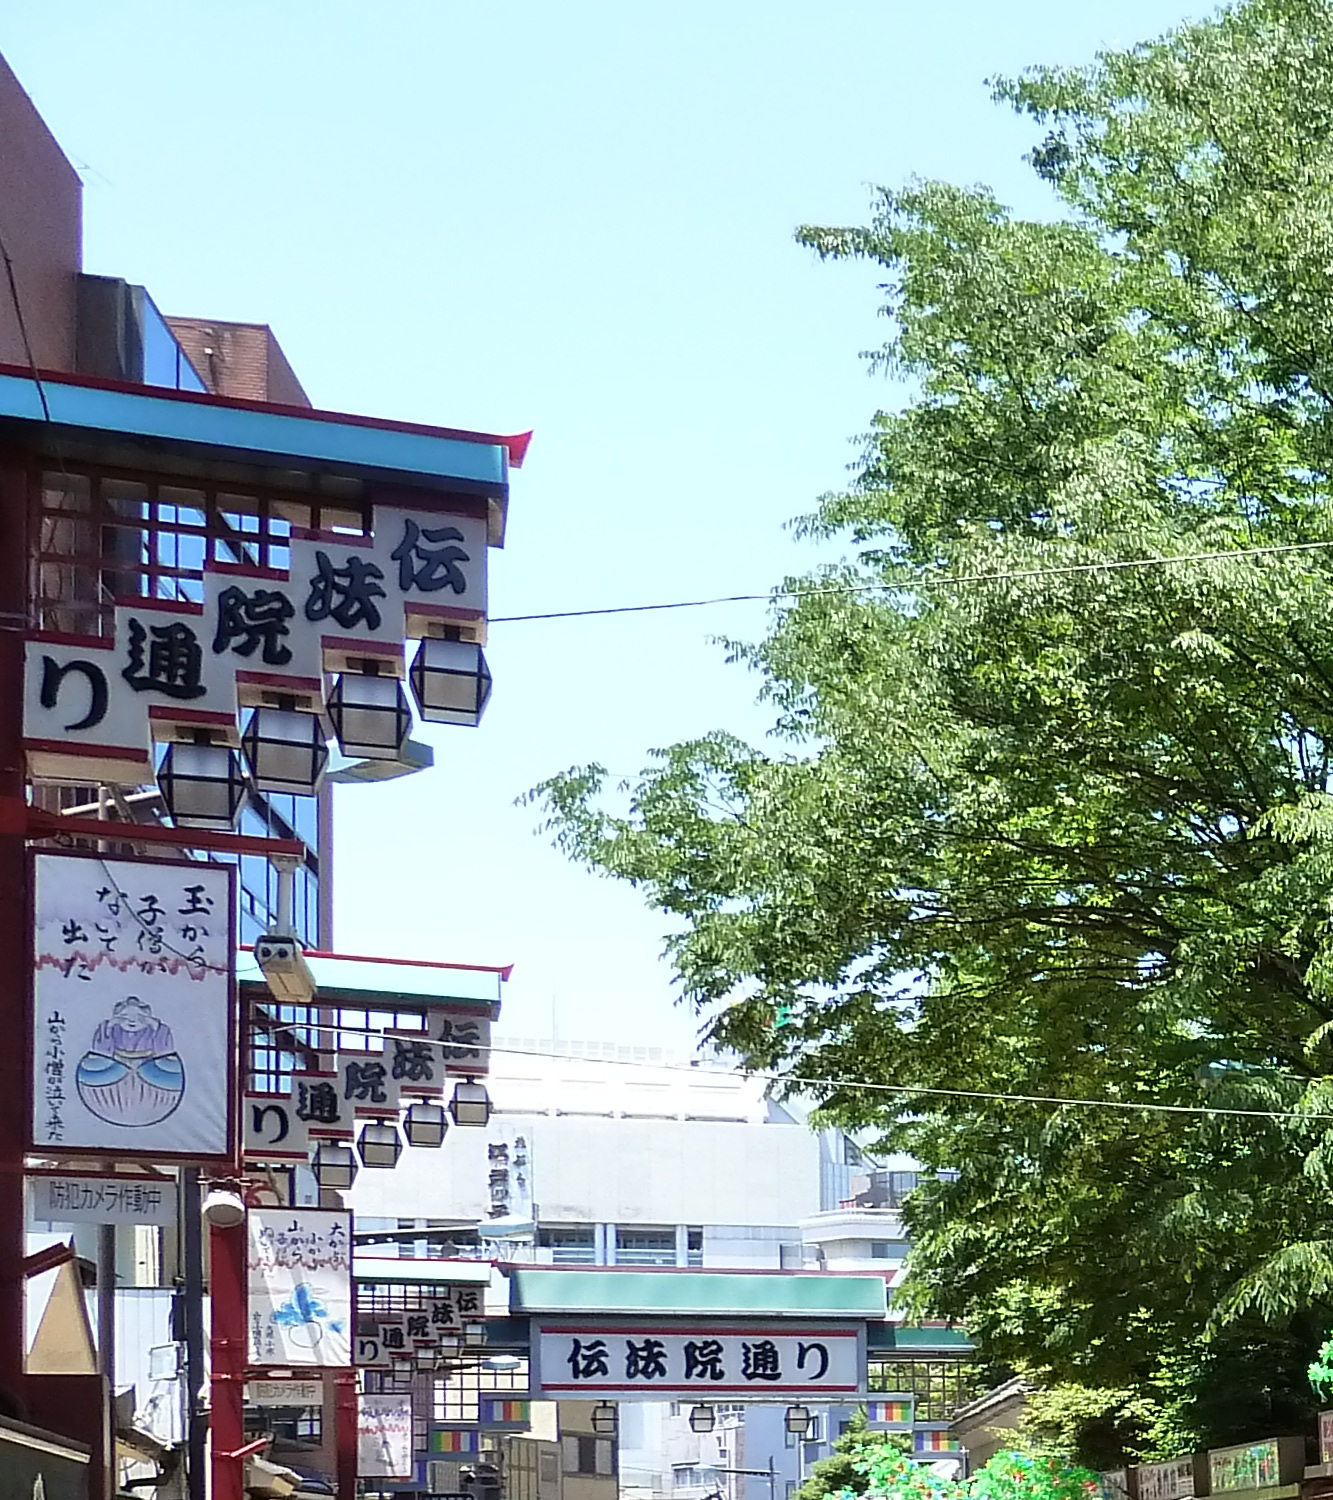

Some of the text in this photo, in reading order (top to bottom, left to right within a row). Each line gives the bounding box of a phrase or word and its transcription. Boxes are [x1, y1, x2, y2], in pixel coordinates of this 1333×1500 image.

[50, 1181, 161, 1214] 防犯カメラ作動中
[567, 1338, 829, 1380] 伝法院通り
